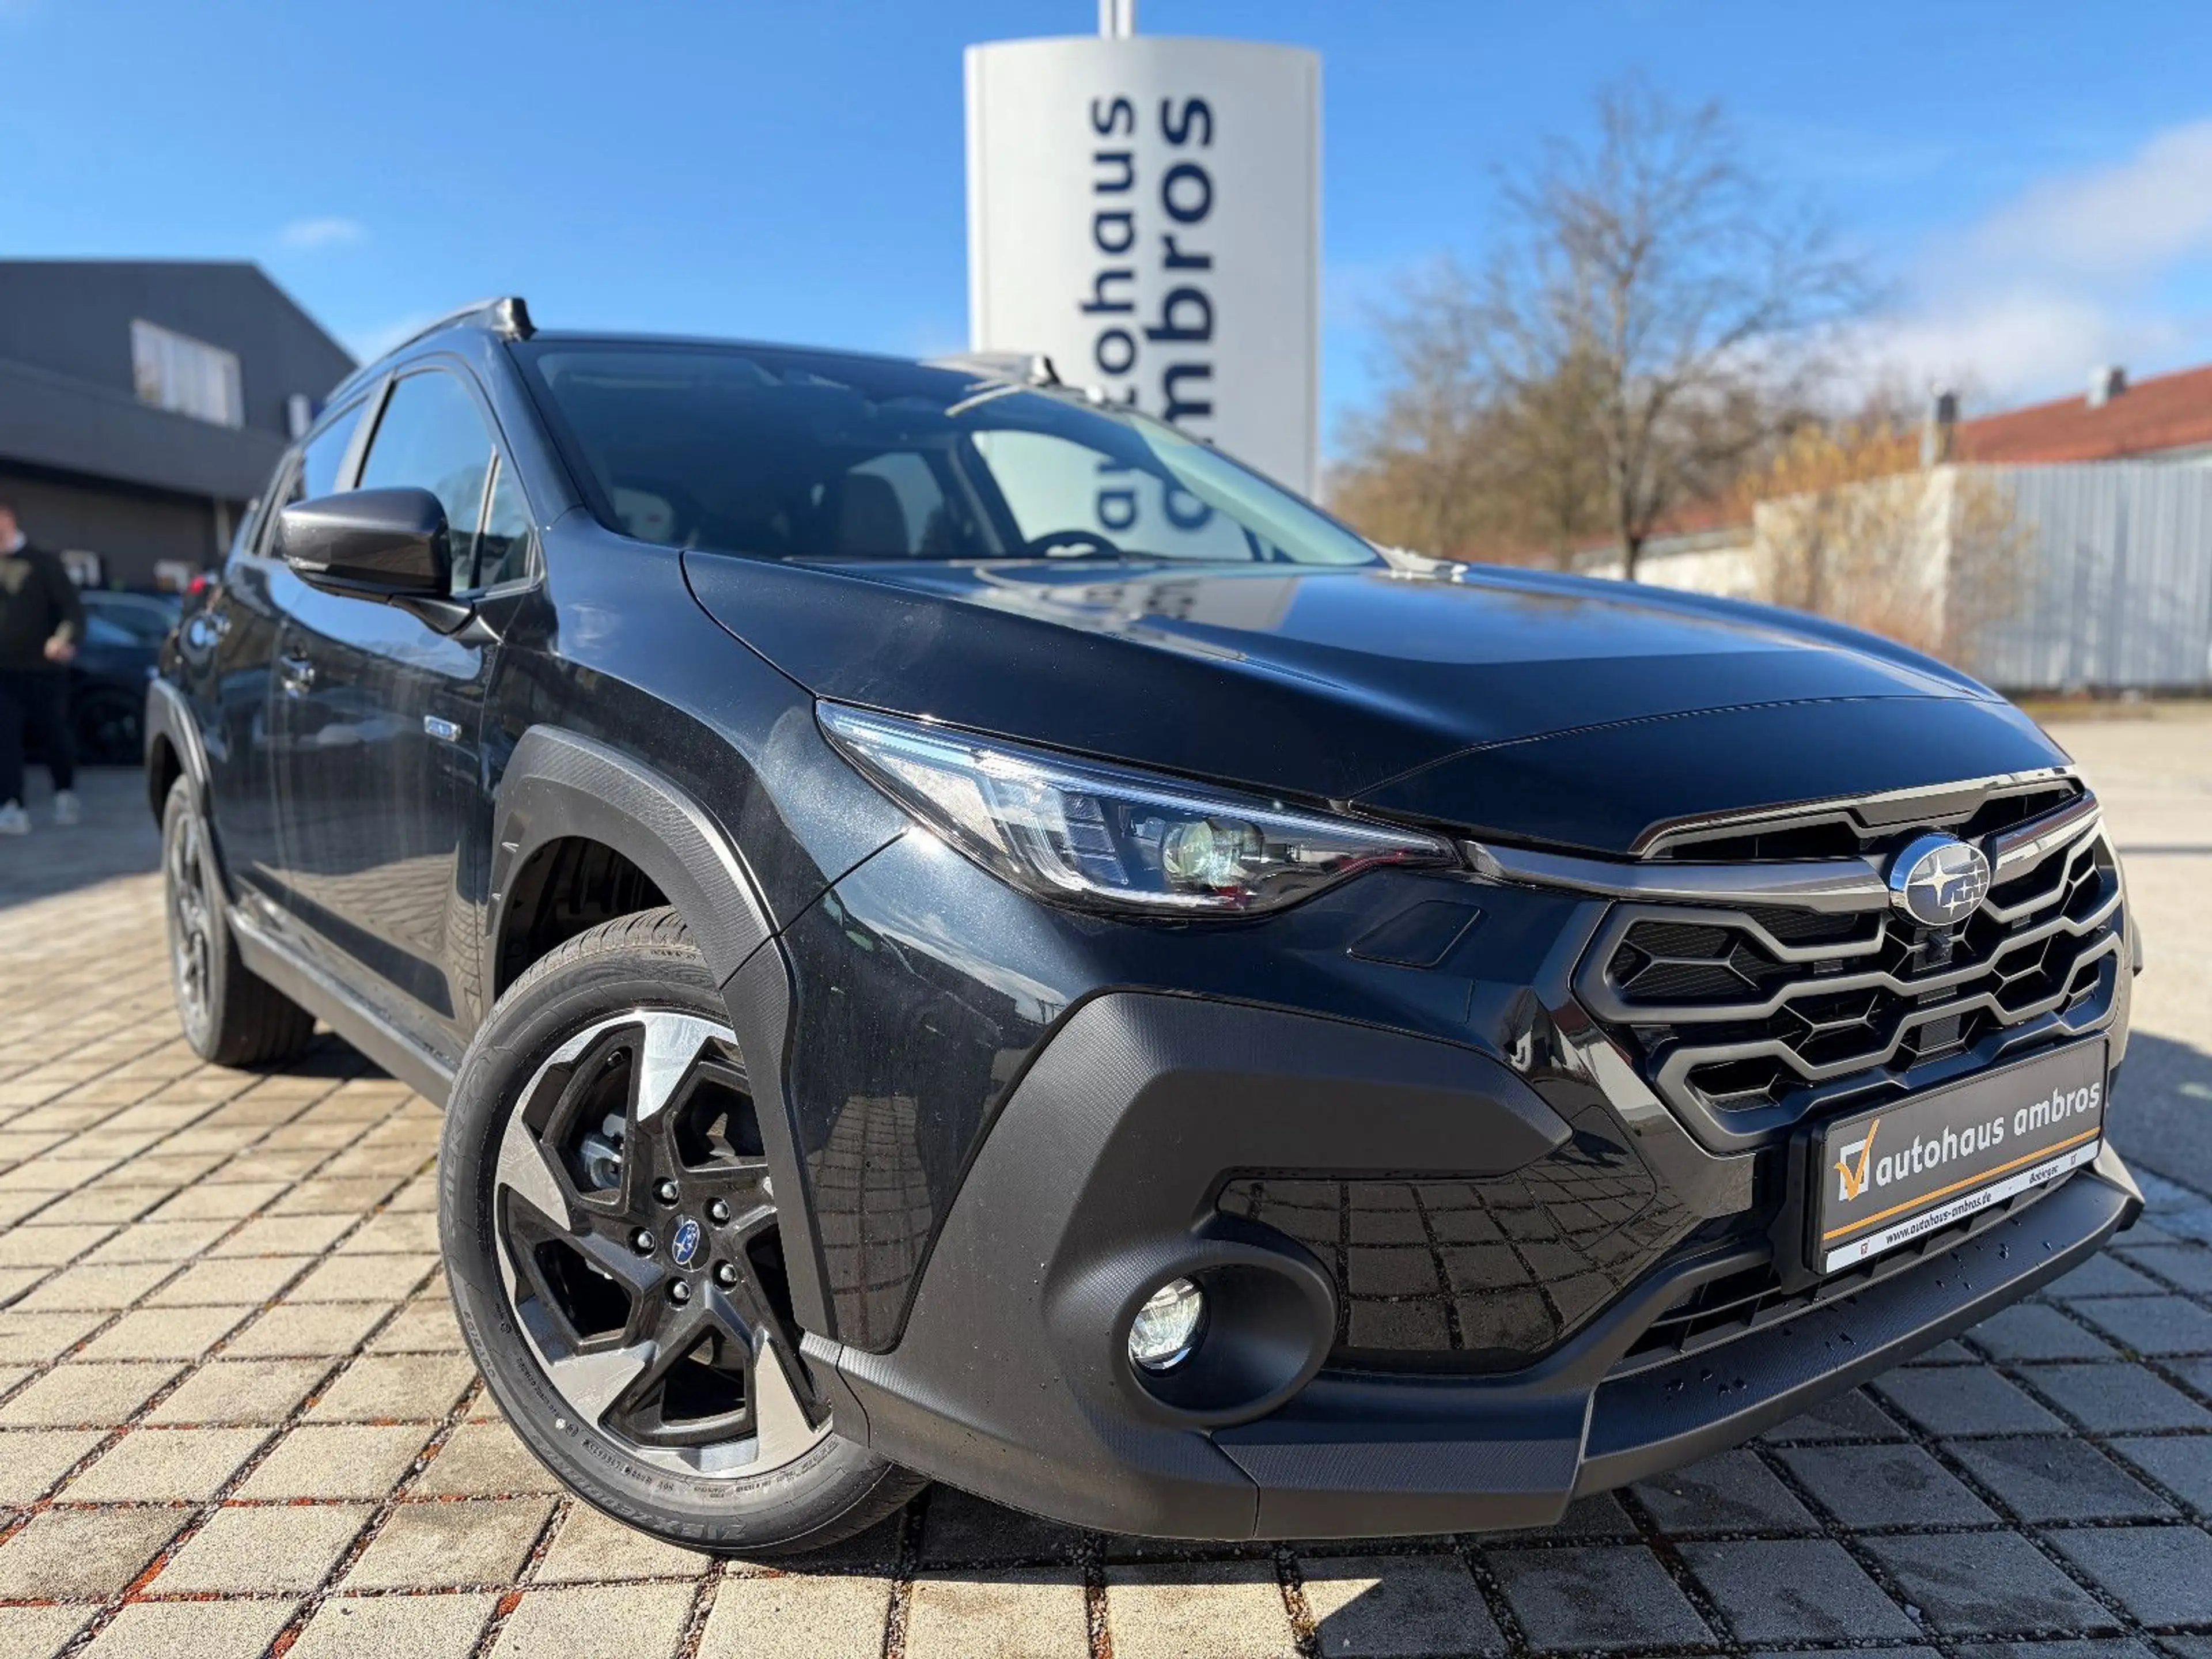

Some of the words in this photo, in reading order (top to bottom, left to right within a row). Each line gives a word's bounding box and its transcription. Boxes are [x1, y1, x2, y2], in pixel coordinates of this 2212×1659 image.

[1876, 1116, 2005, 1187] autohaus
[2014, 1082, 2100, 1136] ambros
[1885, 1191, 1992, 1244] www.autohaus-ambros.de
